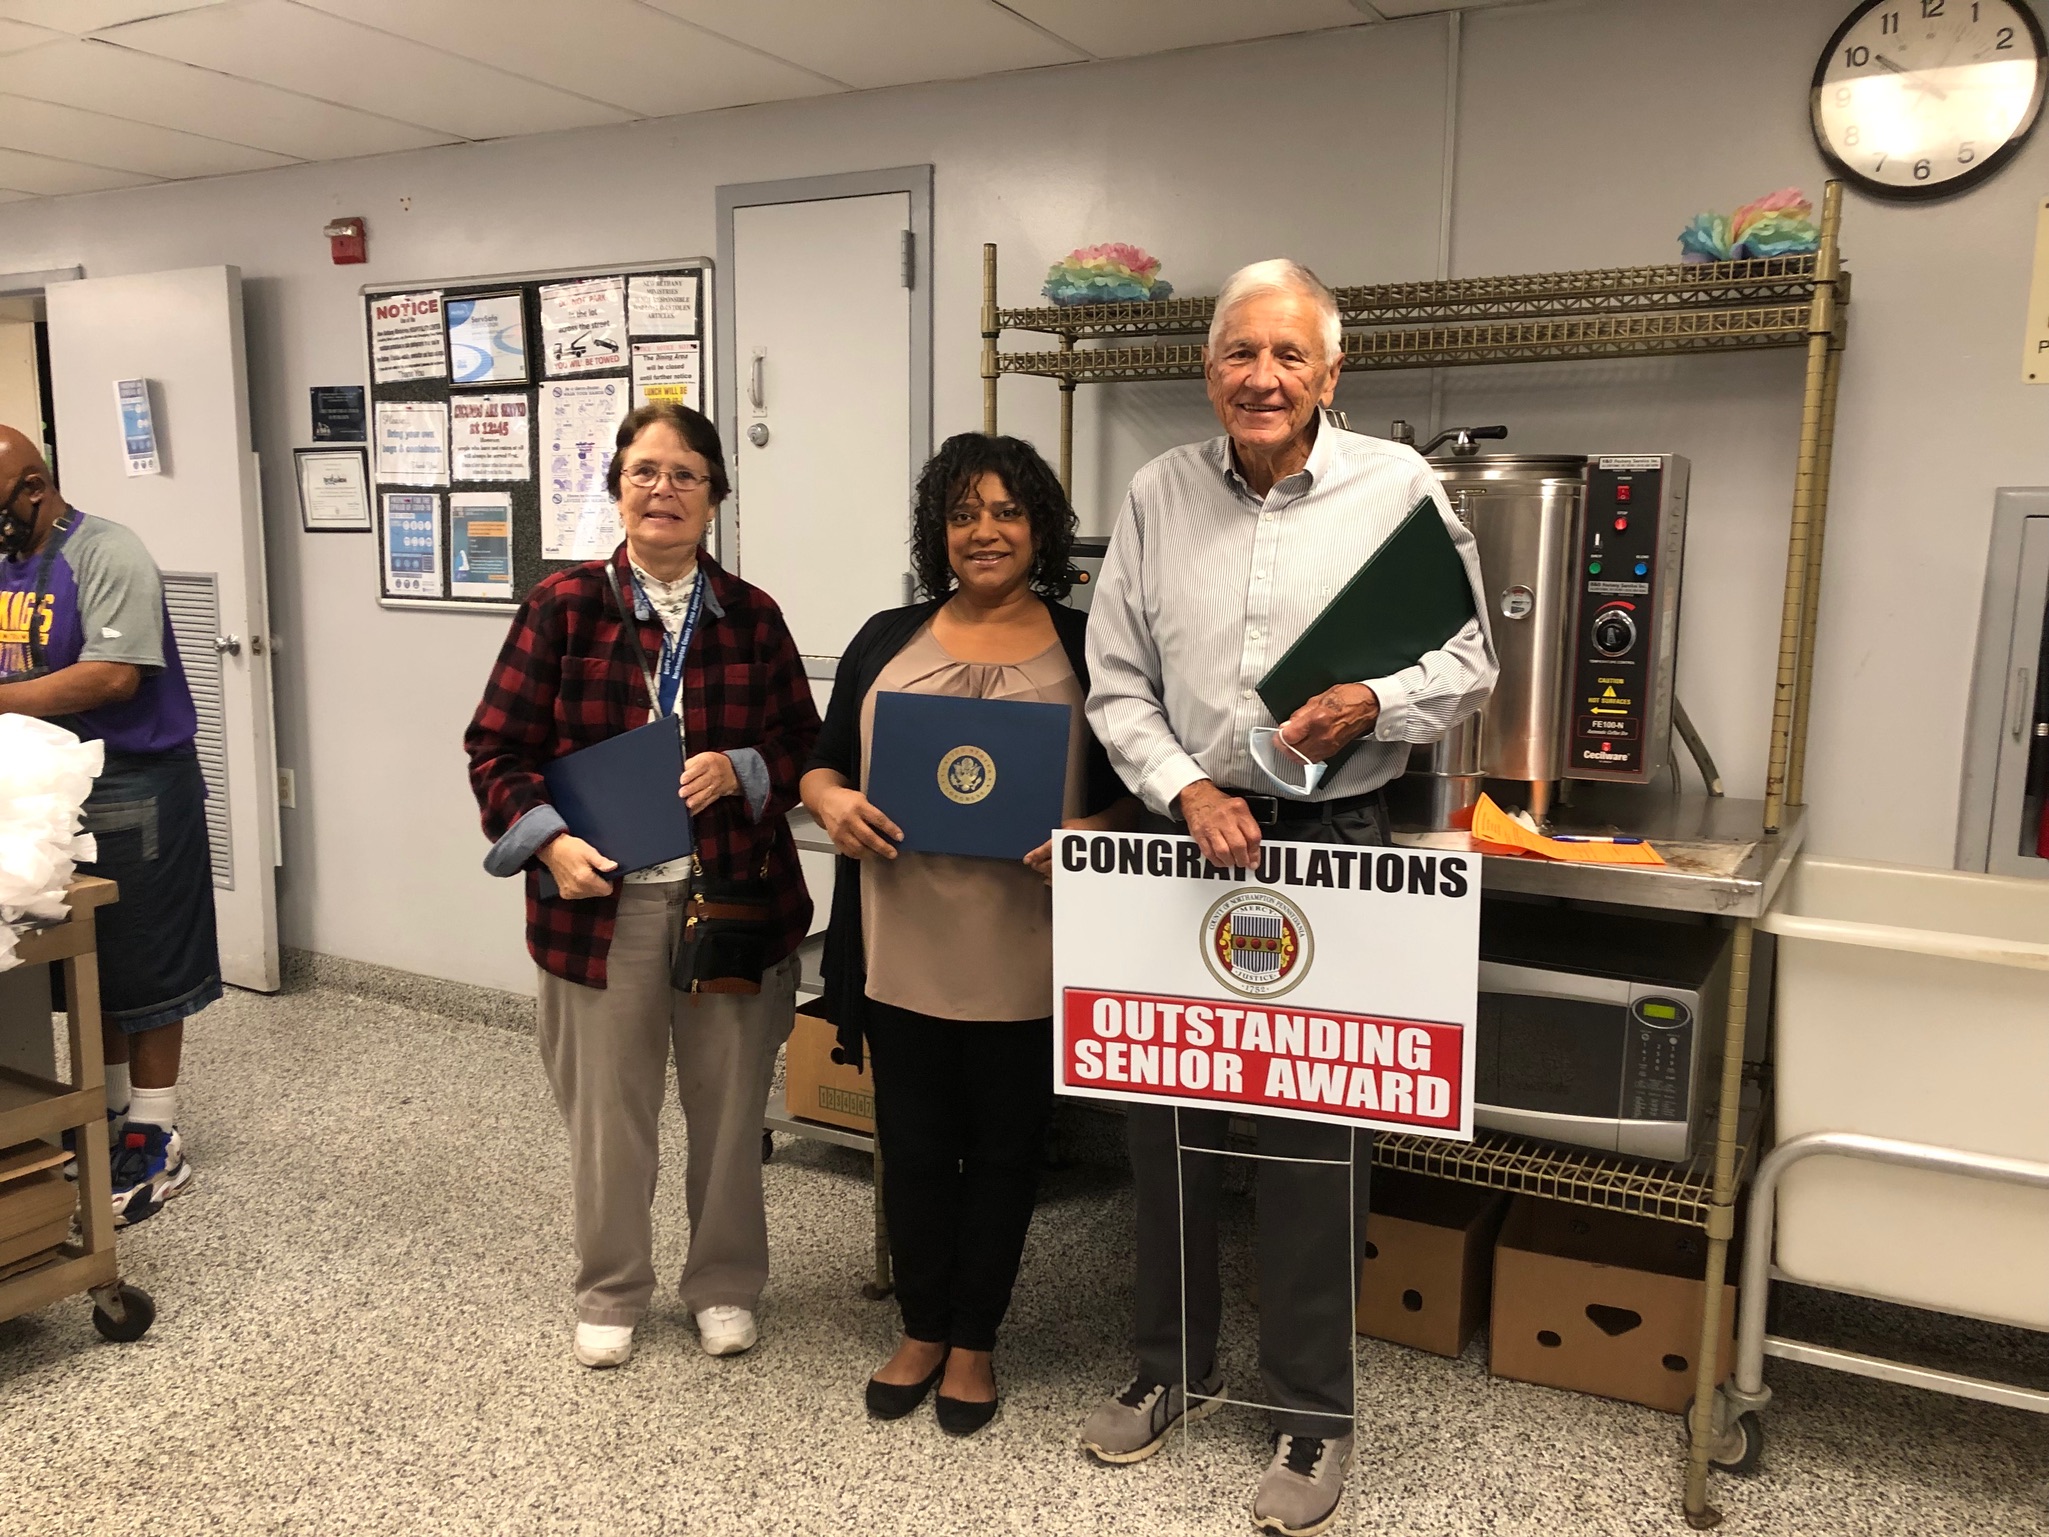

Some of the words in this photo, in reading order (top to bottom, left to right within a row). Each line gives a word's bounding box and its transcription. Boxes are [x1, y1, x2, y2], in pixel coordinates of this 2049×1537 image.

[1919, 0, 1944, 18] 12
[1970, 2, 1979, 23] 1
[1881, 12, 1898, 35] 11
[1996, 27, 2014, 50] 2
[1845, 46, 1870, 68] 10
[1835, 87, 1851, 108] 9
[1844, 126, 1859, 147] 8
[1873, 152, 1888, 173] 7
[1957, 142, 1975, 164] 5
[1913, 159, 1931, 180] 6
[376, 299, 439, 320] NOTICE
[595, 355, 620, 365] TOWED
[680, 627, 693, 646] County
[687, 611, 696, 624] Area
[1601, 697, 1631, 705] SURFACES
[1592, 720, 1624, 729] FE100-N
[1583, 750, 1628, 761] Cecilware
[1209, 908, 1222, 930] COUNTY
[1222, 902, 1231, 911] OF
[1230, 894, 1275, 905] NORTHAMPTON
[1275, 899, 1305, 937] PENNSYLVANIA
[1240, 906, 1273, 915] MERCY
[1237, 971, 1275, 982] JUSTICE
[1245, 985, 1266, 993] 1752
[1092, 997, 1431, 1071] OUTSTANDING
[1074, 1039, 1243, 1094] SENIOR
[1264, 1057, 1451, 1118] AWARD
